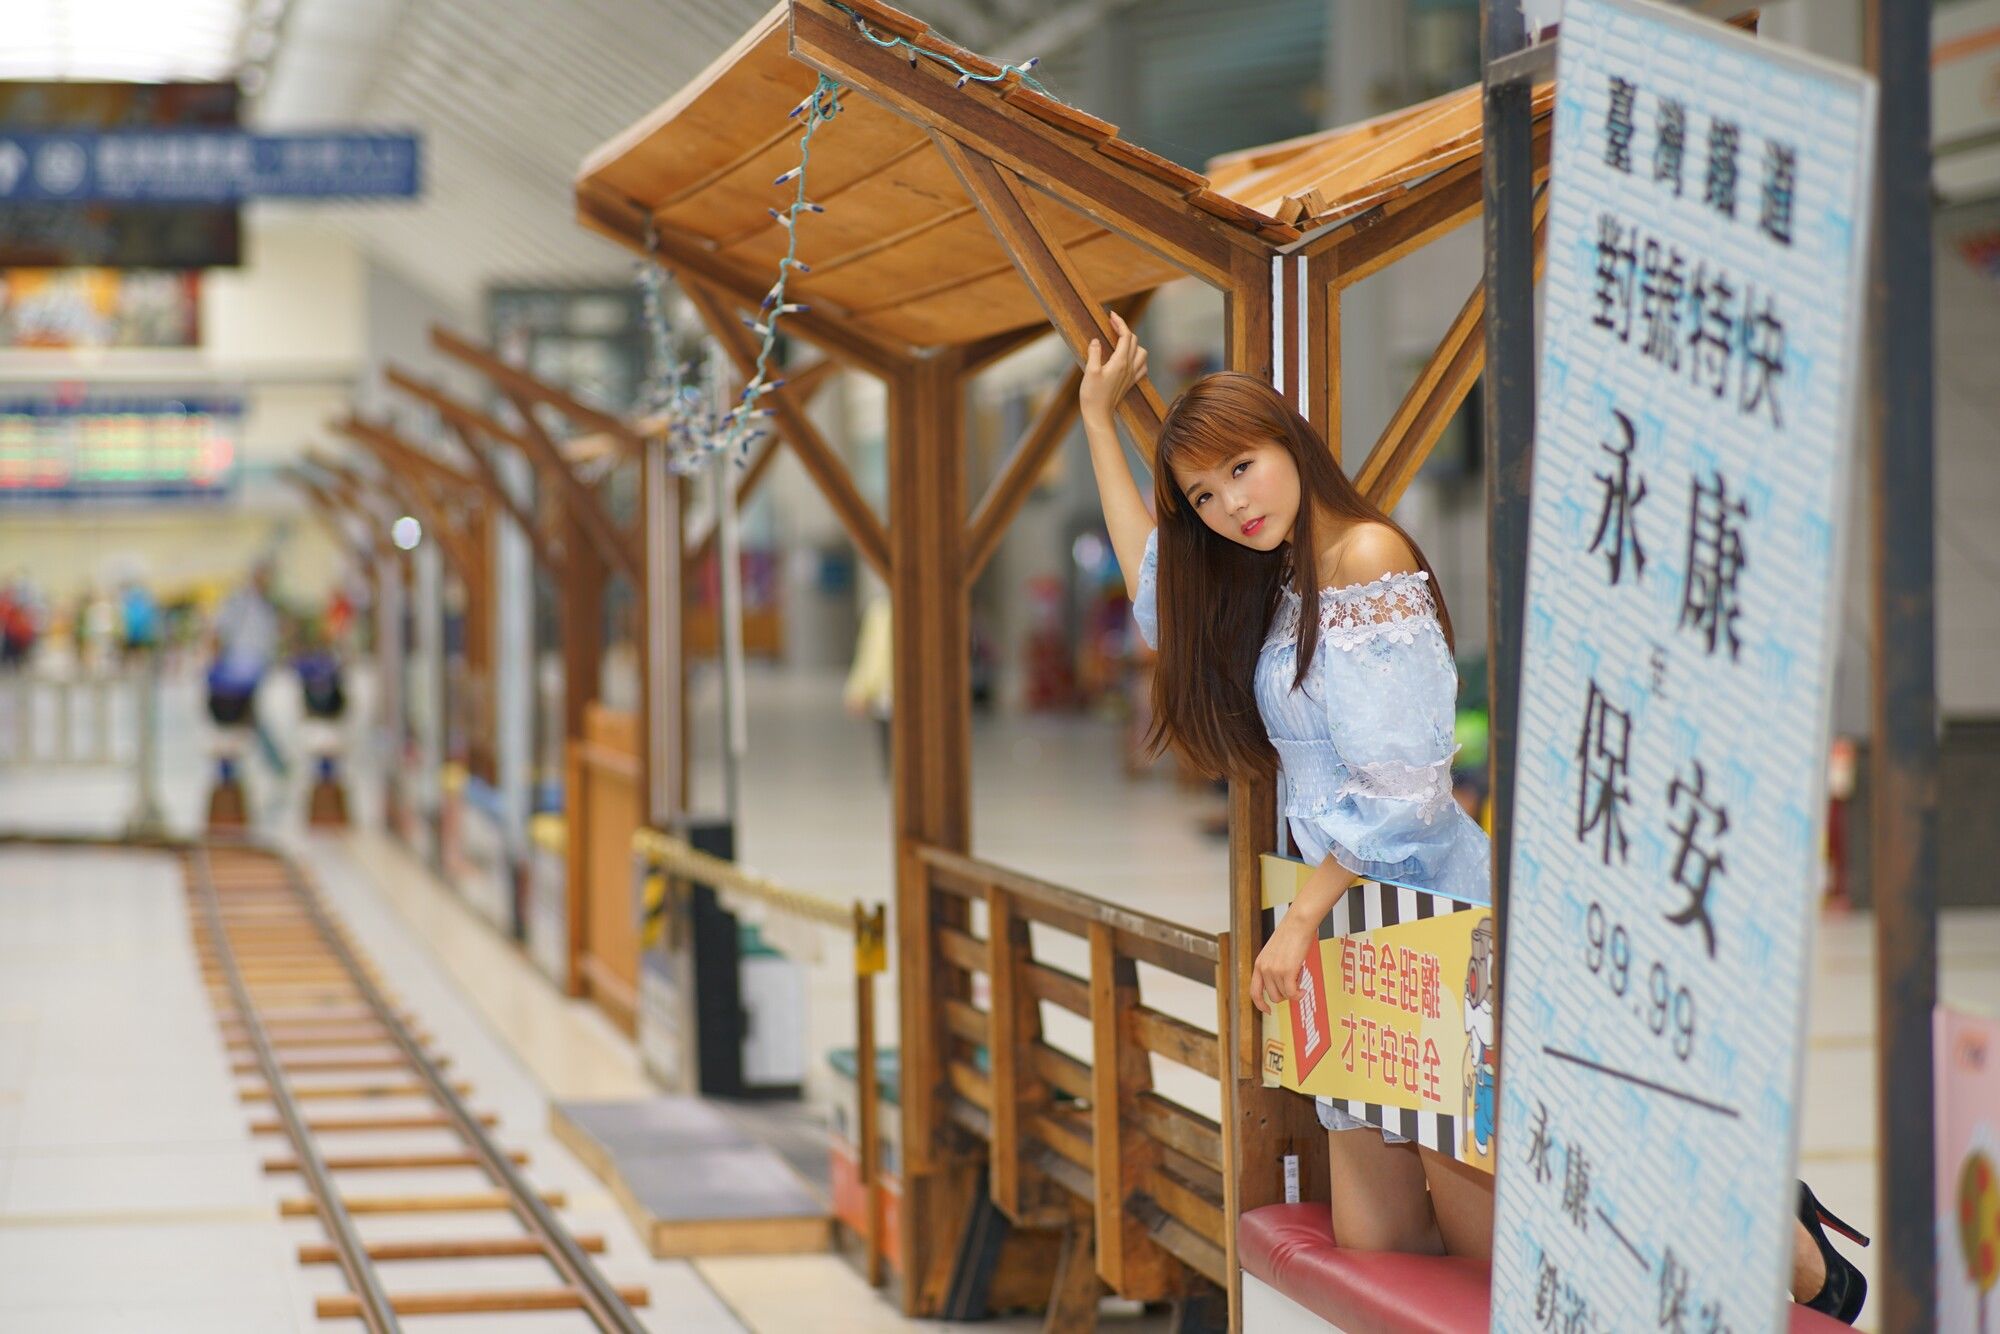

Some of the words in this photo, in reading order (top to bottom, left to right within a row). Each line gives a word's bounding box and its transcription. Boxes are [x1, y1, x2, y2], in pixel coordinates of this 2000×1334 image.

[1592, 212, 1785, 430] 對號特快
[1587, 408, 1750, 665] 永康
[1576, 678, 1730, 960] 保安
[1340, 933, 1441, 1020] 有安全距離
[1341, 1012, 1442, 1103] 才平安安全
[1584, 901, 1696, 1063] 99.99
